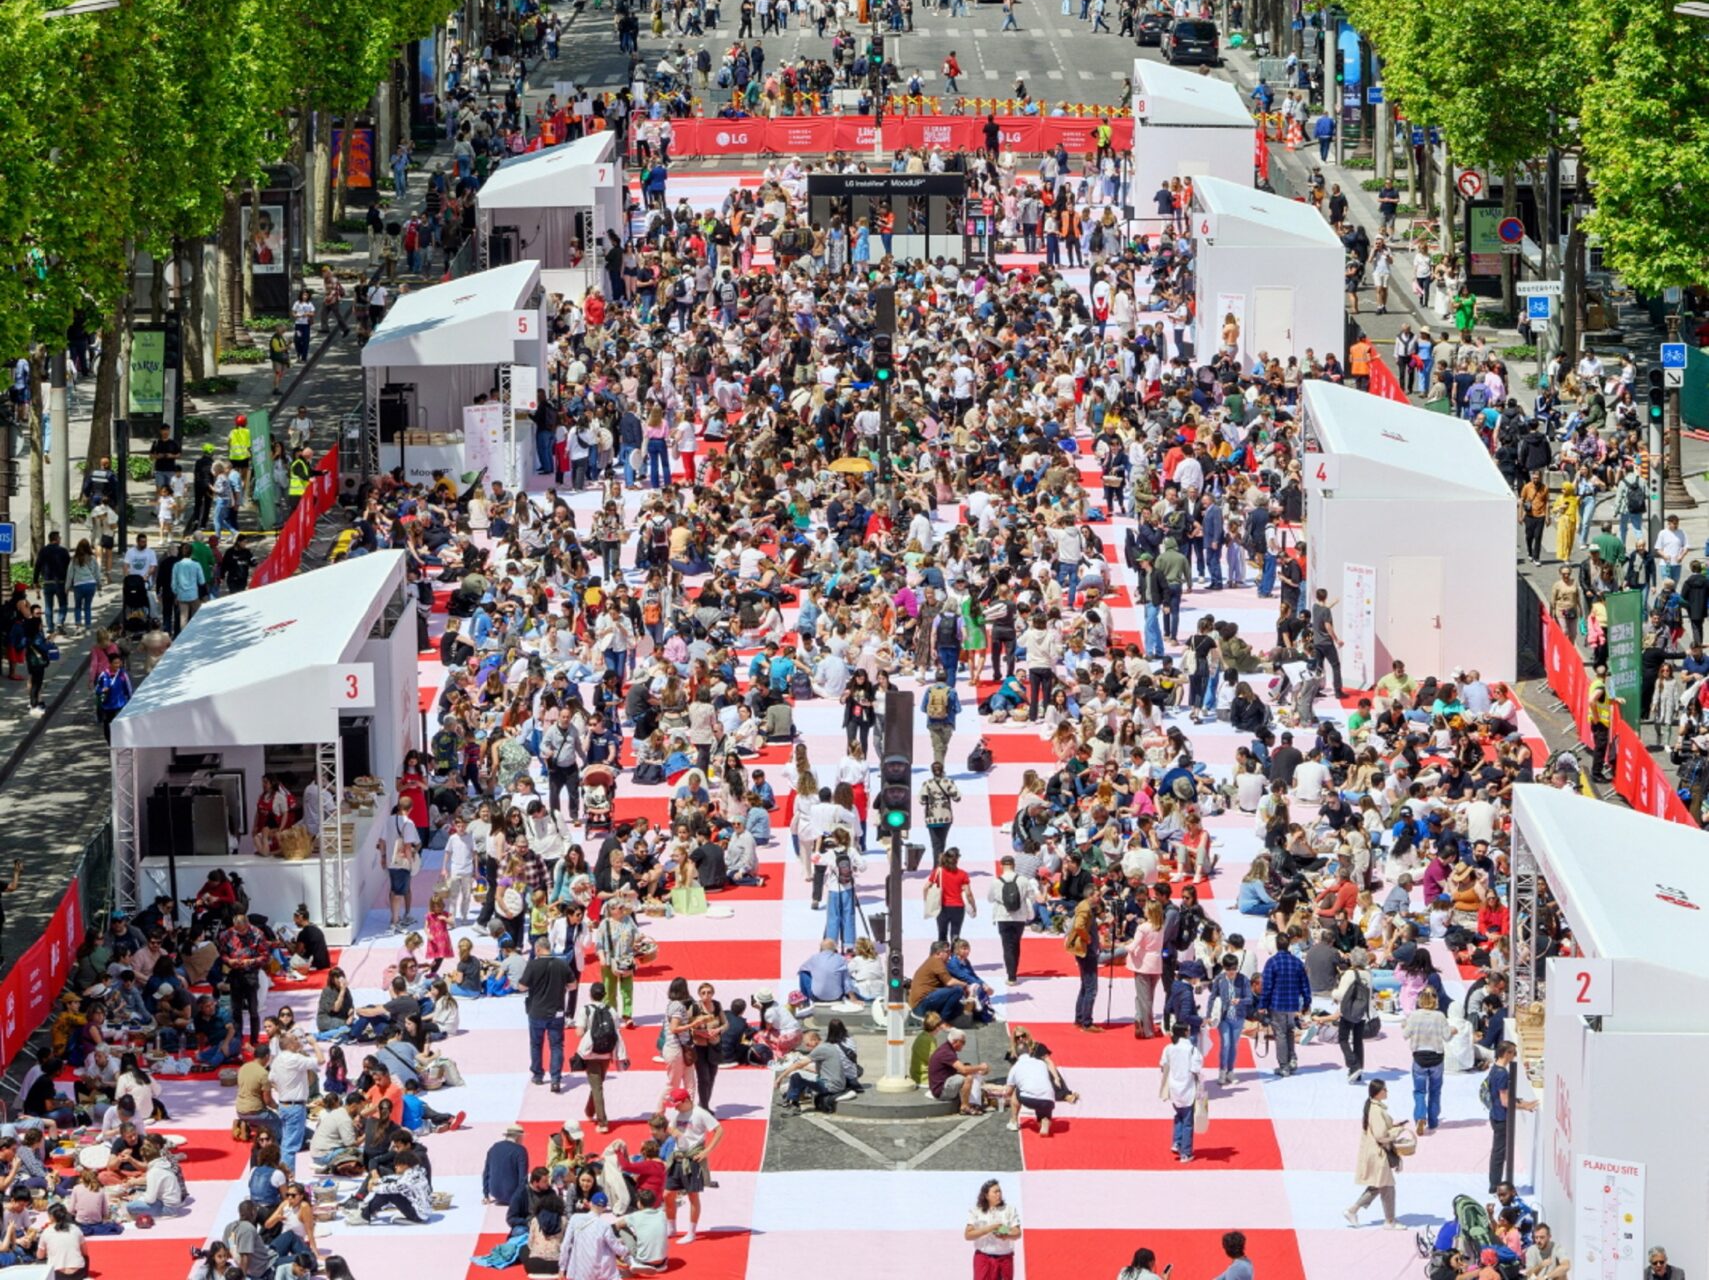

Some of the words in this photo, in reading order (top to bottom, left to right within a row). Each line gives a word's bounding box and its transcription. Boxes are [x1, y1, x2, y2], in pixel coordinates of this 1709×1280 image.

[1139, 100, 1145, 112] 8
[731, 133, 748, 145] LG
[1006, 132, 1021, 143] LG
[598, 169, 606, 182] 7
[1201, 220, 1209, 234] 6
[518, 317, 527, 333] 5
[1316, 462, 1327, 482] 4
[345, 674, 358, 699] 3
[1576, 972, 1591, 1003] 2
[1584, 1160, 1606, 1172] PLAN
[1607, 1163, 1619, 1174] DU
[1621, 1166, 1639, 1177] SITE
